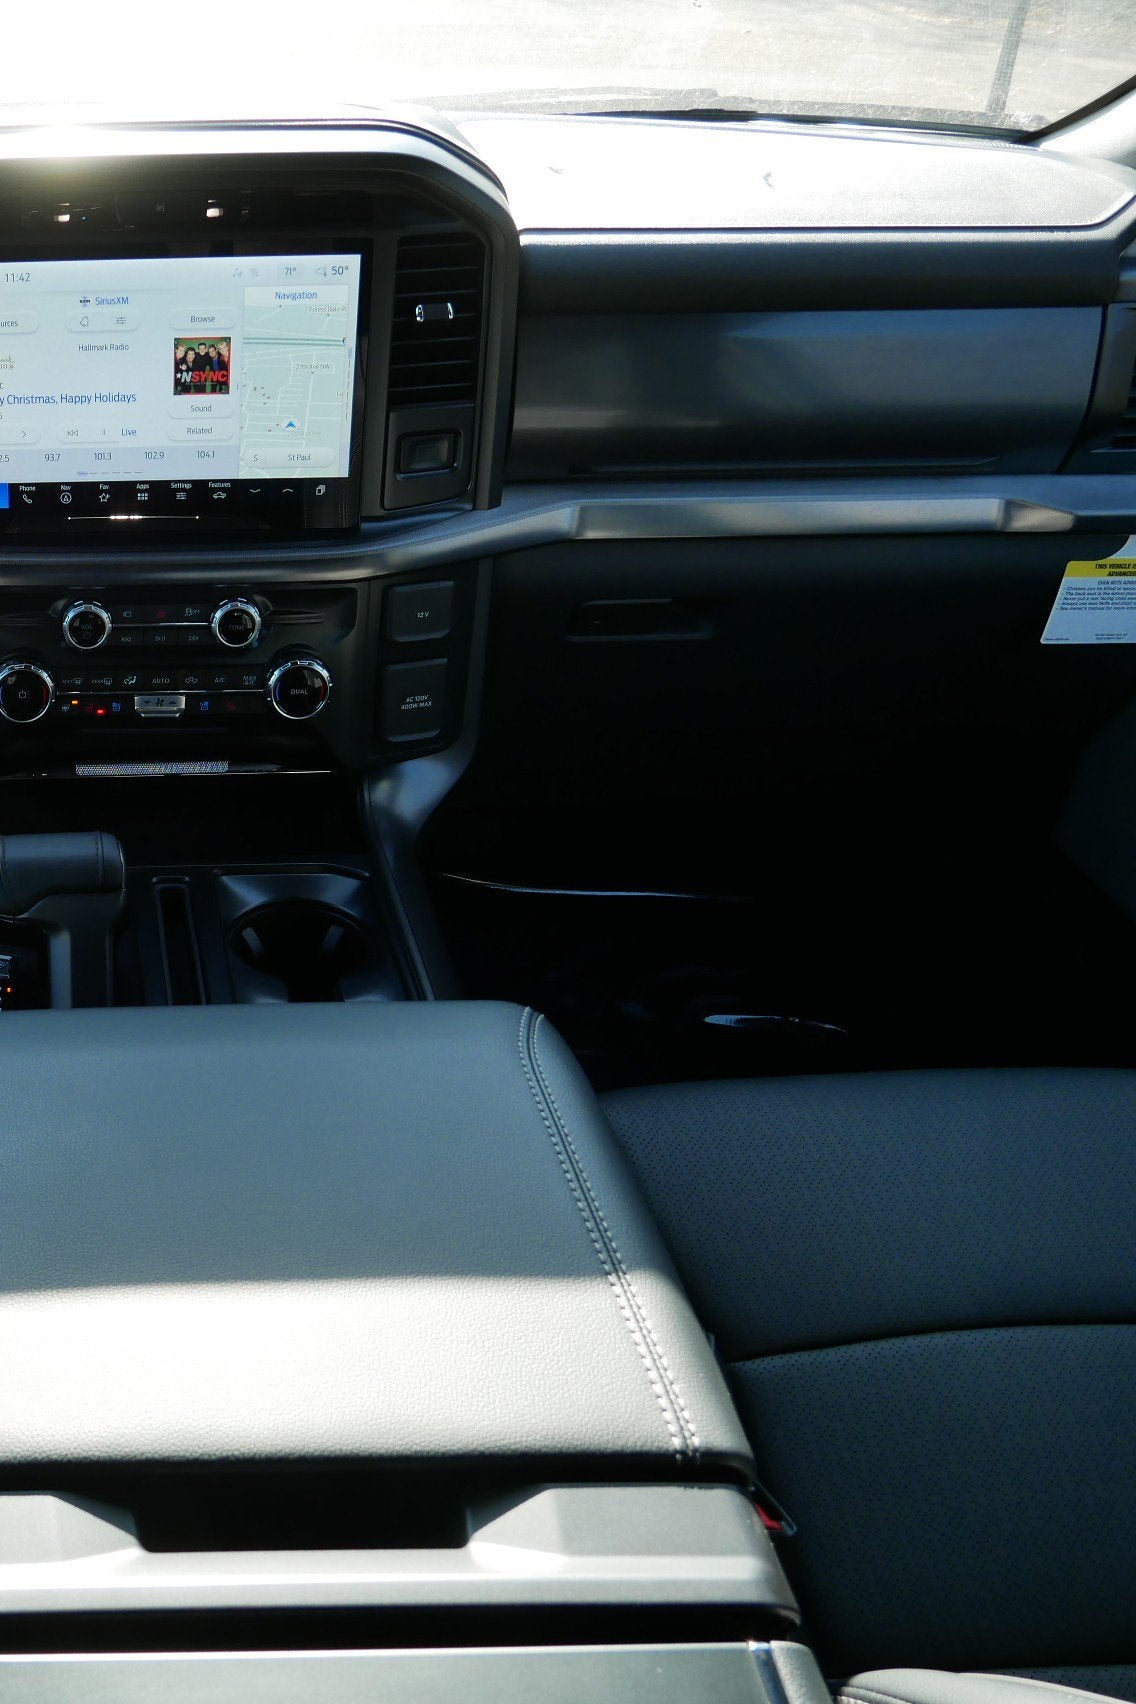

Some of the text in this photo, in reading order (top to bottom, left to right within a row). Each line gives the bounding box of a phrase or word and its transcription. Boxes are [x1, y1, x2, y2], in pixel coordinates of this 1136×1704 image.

[284, 267, 297, 276] 71°
[331, 266, 349, 276] 50°
[5, 273, 31, 283] 11:42
[274, 291, 318, 301] Navigation
[94, 296, 129, 306] SiriusXM
[78, 343, 129, 352] Hallmark Radio
[6, 394, 58, 405] Christmas,
[60, 393, 92, 405] Happy
[94, 392, 137, 404] Holidays
[190, 404, 212, 413] Sound
[121, 428, 137, 437] Live
[186, 427, 213, 435] Related
[44, 454, 61, 462] 93.7
[94, 452, 112, 461] 101.3
[144, 451, 165, 460] 102.9
[196, 451, 216, 459] 104.1
[254, 454, 259, 462] S
[288, 454, 312, 462] St Paul
[170, 482, 193, 490] Settings
[415, 694, 429, 702] 120V
[420, 700, 433, 708] MAX
